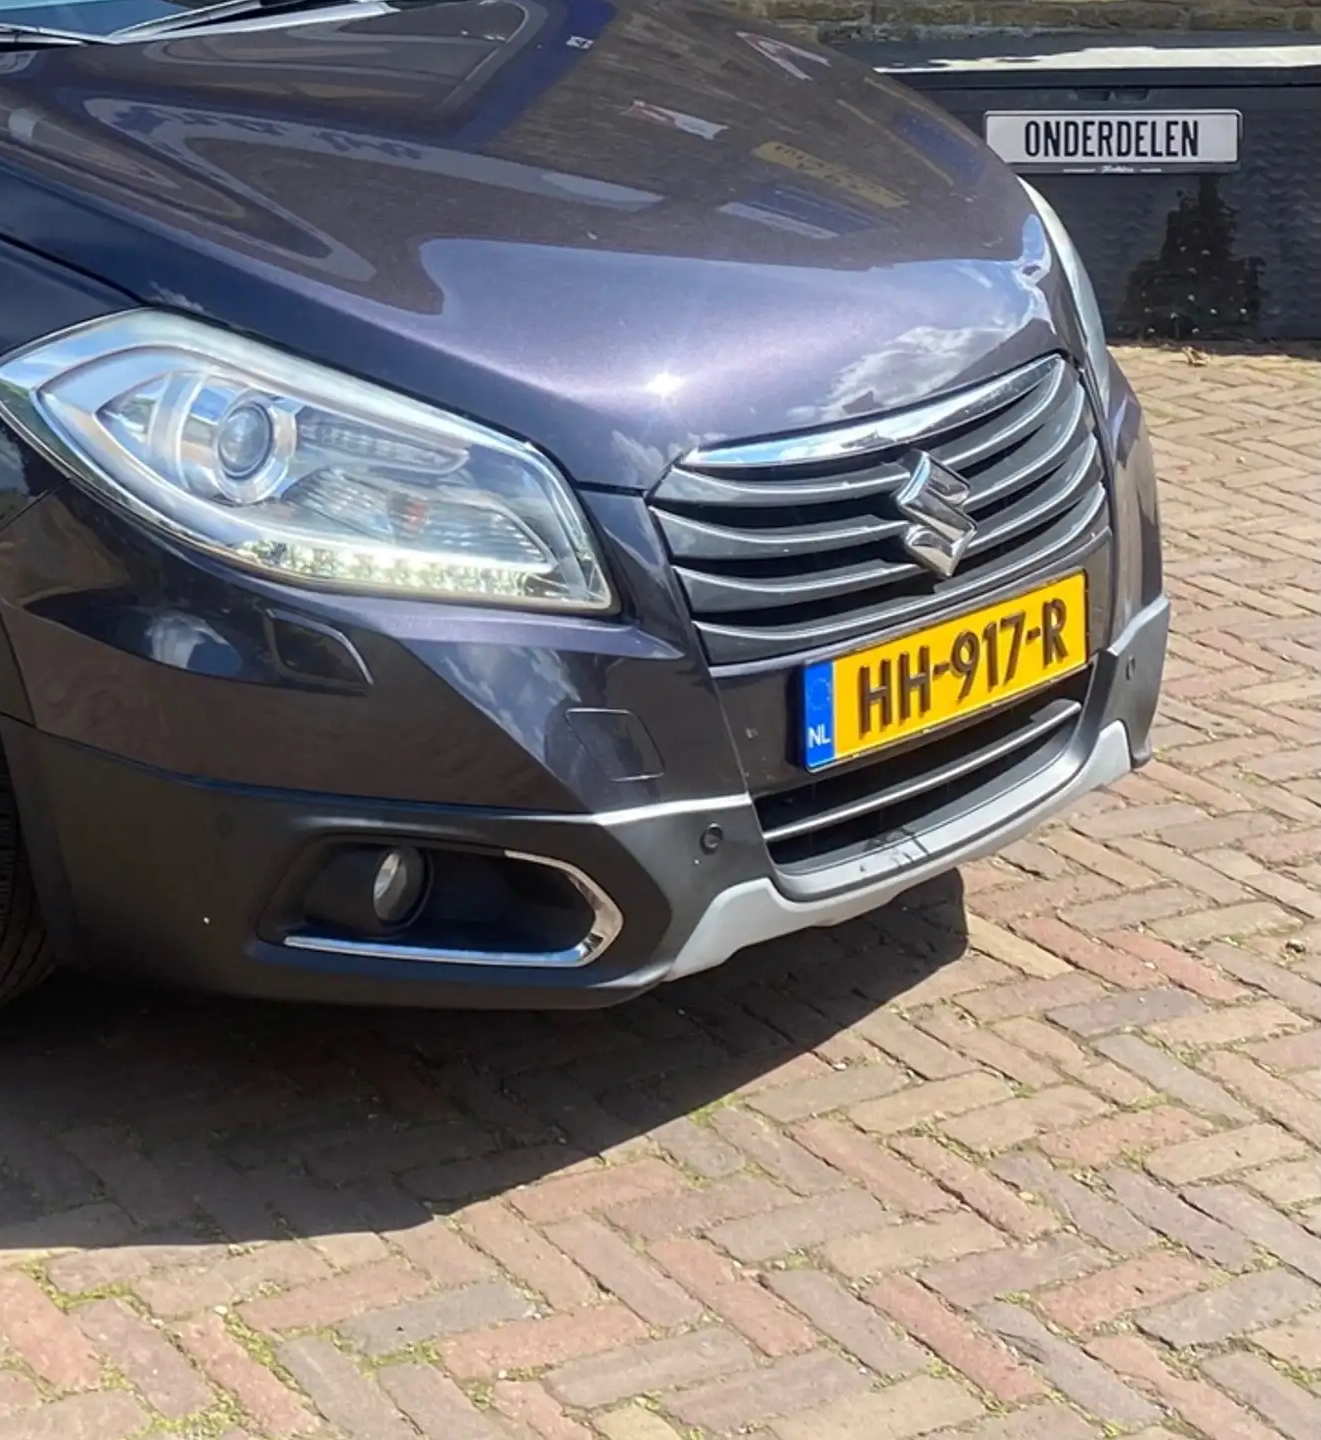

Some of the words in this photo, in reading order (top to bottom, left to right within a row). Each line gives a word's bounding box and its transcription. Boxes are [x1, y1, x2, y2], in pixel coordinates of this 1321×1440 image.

[1024, 120, 1199, 158] ONDERDELEN
[857, 597, 1069, 740] HH-917-R
[807, 723, 831, 749] NL
